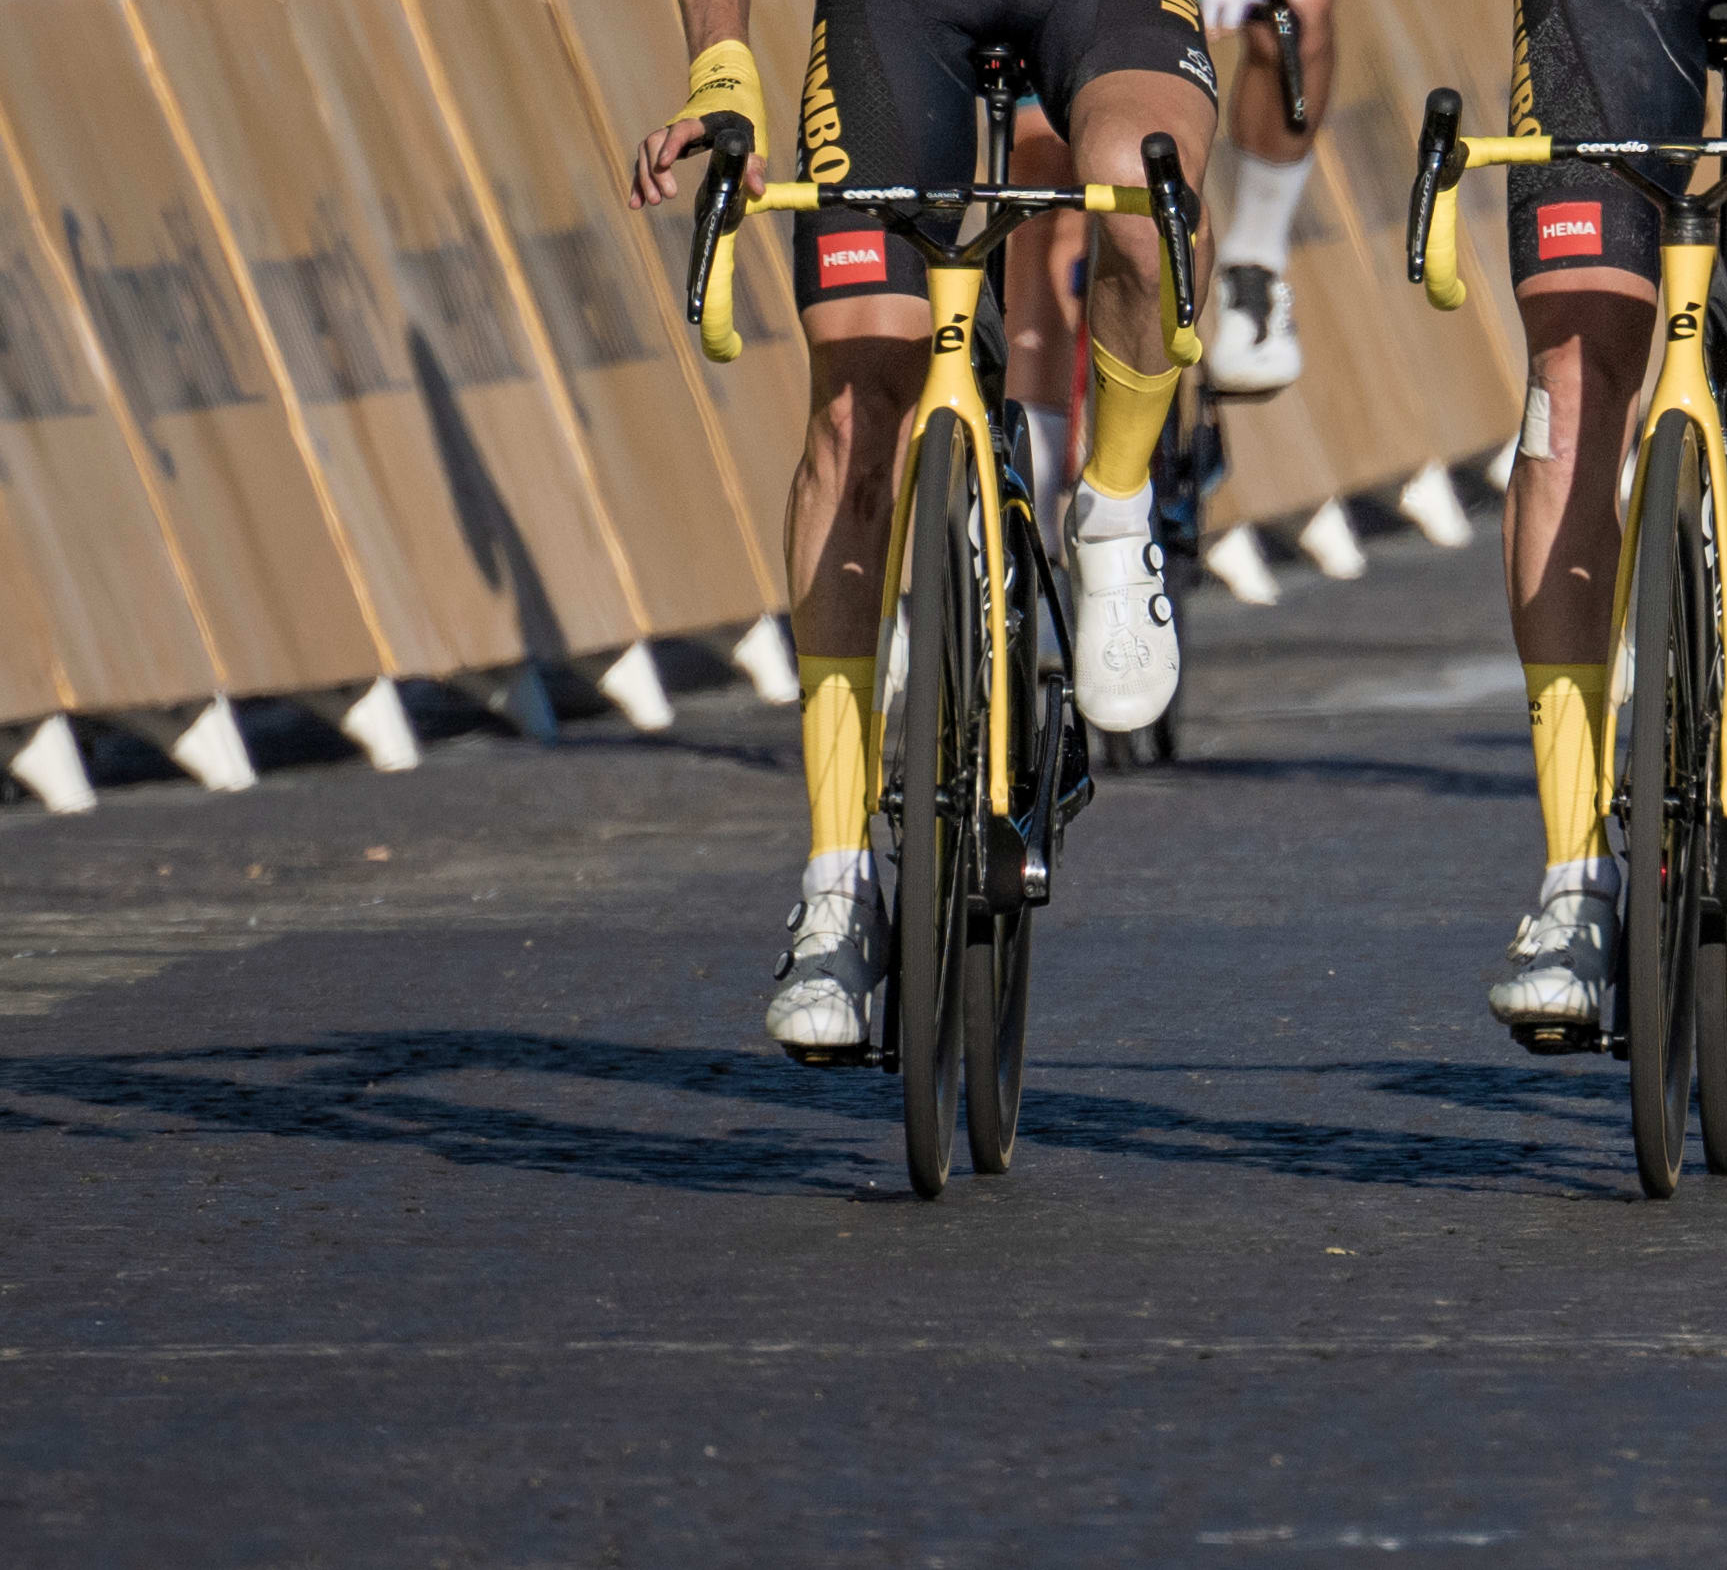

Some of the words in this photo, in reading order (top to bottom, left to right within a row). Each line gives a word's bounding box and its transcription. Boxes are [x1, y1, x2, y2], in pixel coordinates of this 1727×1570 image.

[1576, 140, 1649, 154] cervélo
[842, 185, 919, 201] cervélo
[925, 190, 961, 200] GARMIN
[1542, 220, 1597, 239] HEMA
[822, 248, 881, 269] HEMA
[1668, 301, 1703, 343] é
[935, 312, 969, 355] é
